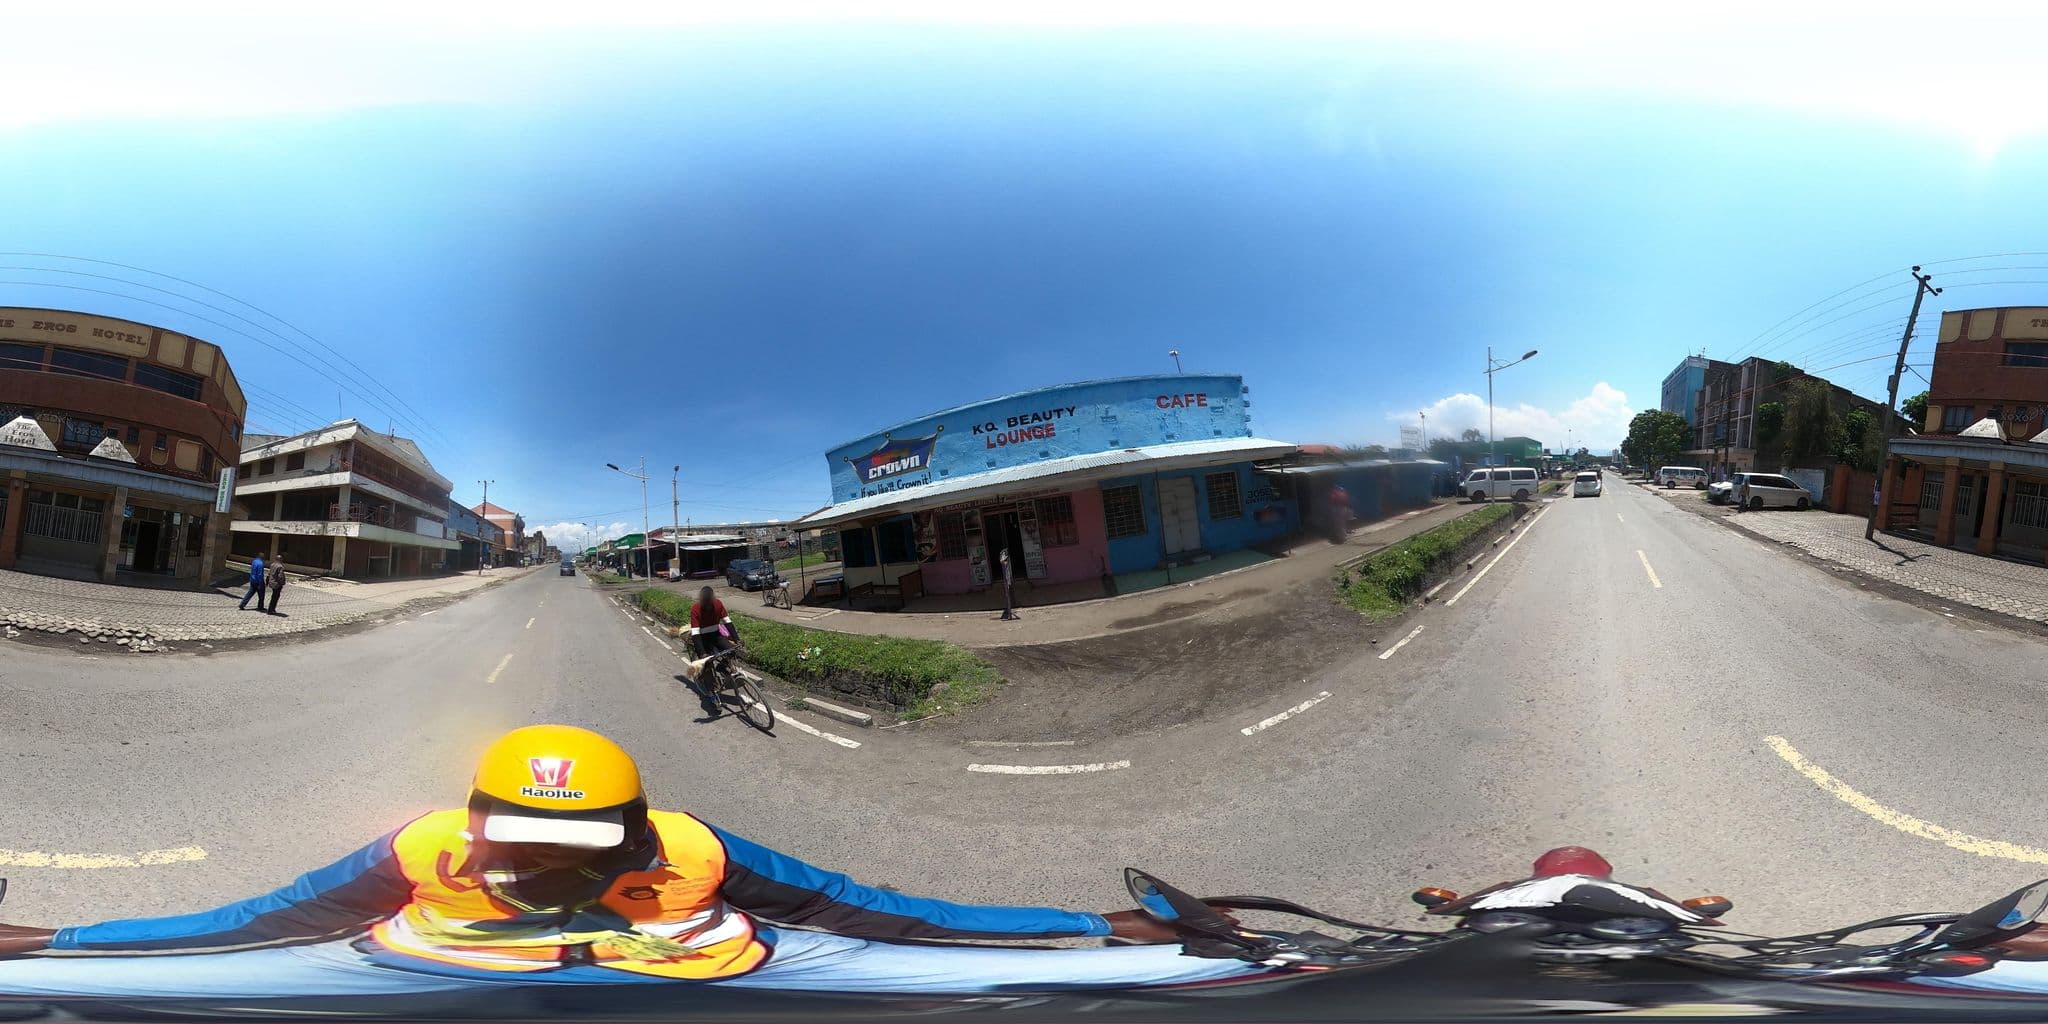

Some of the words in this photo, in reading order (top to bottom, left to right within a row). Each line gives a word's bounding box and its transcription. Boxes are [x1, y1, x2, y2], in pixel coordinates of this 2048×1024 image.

[32, 320, 78, 333] EROS
[92, 327, 147, 345] HOTEL
[1156, 393, 1208, 409] CAFE
[972, 422, 998, 435] KQ
[1007, 406, 1076, 428] BEAUTY
[16, 423, 32, 431] The
[12, 429, 34, 437] Eros
[986, 423, 1056, 449] LOUNGE
[4, 435, 36, 445] Hotel
[897, 479, 922, 489] Crown
[522, 787, 584, 798] Haojue
